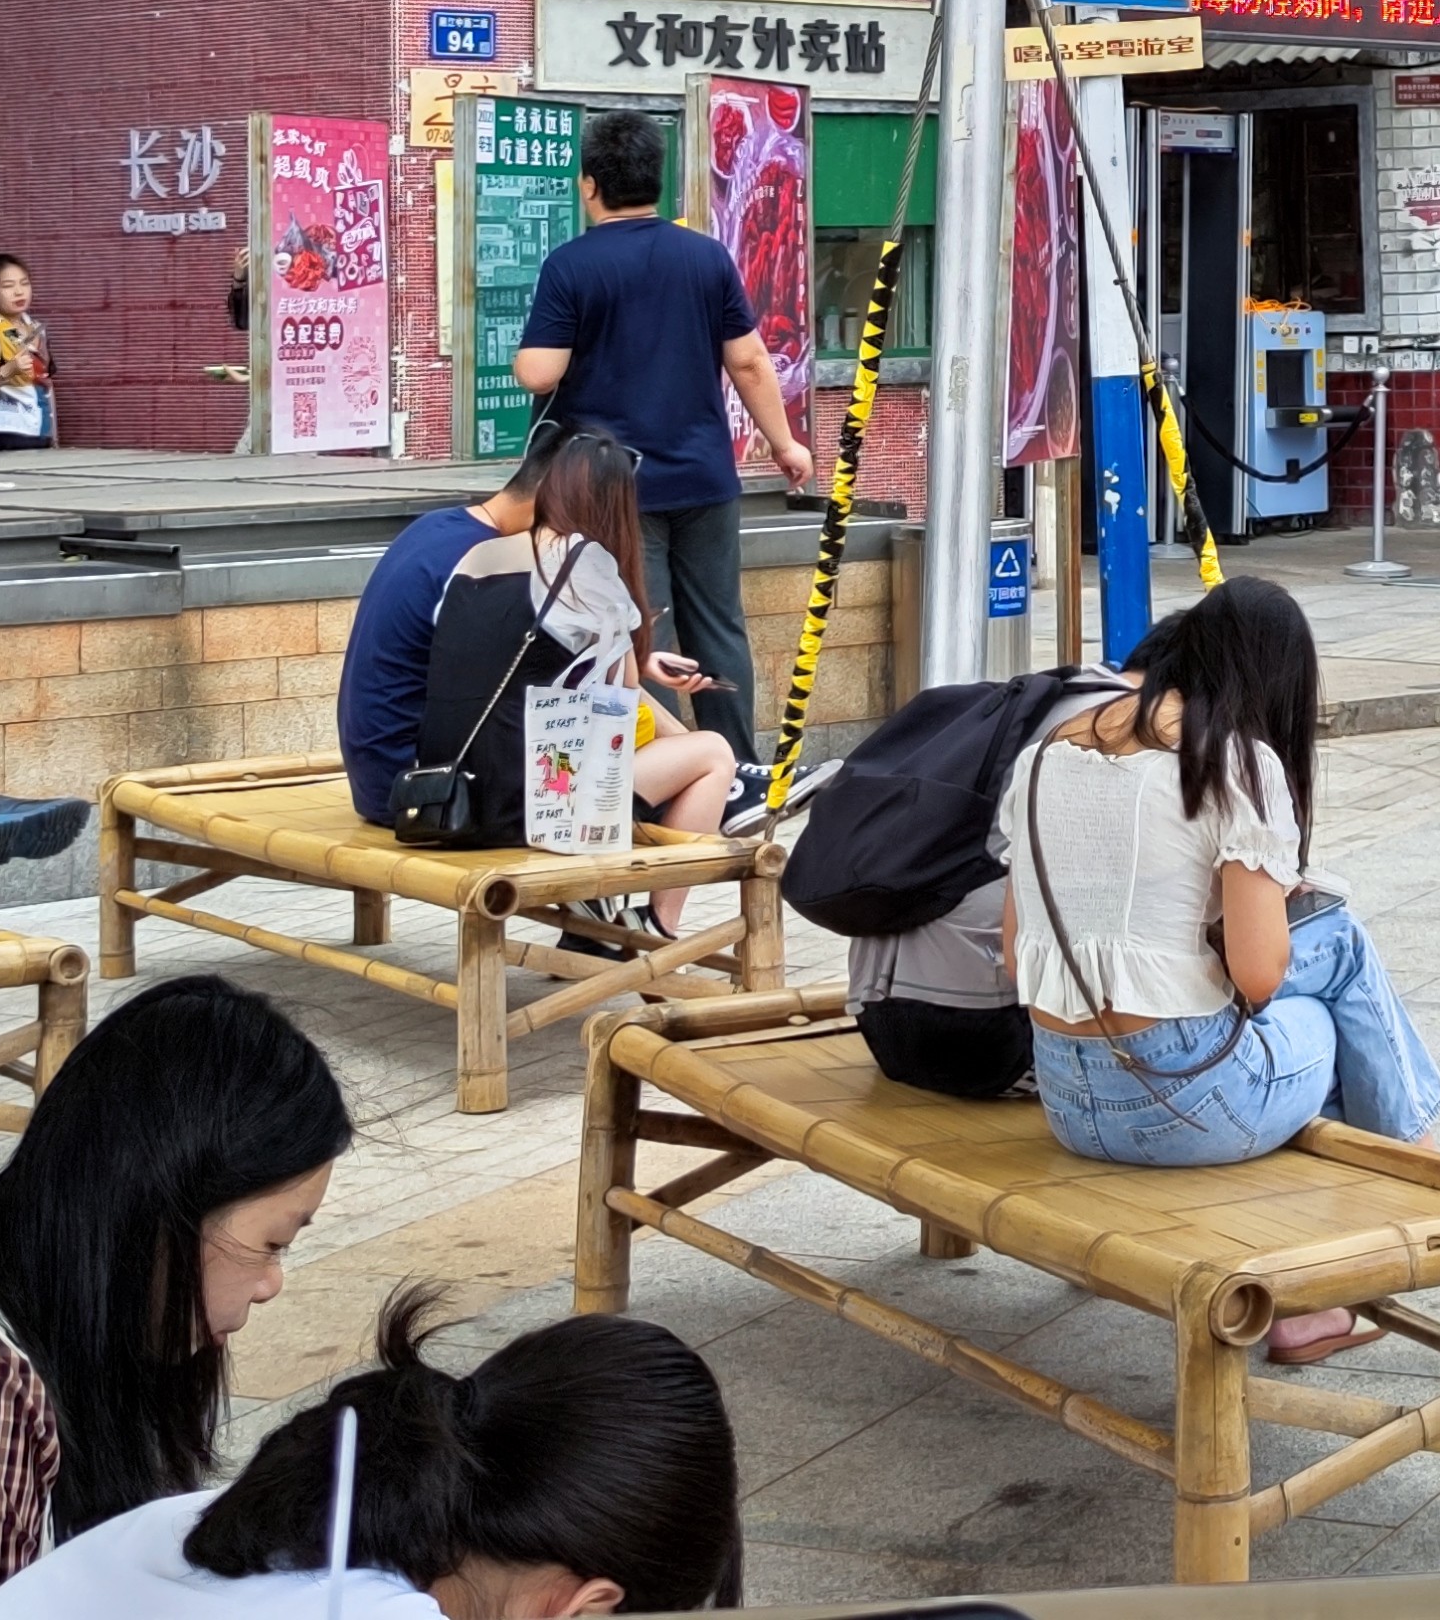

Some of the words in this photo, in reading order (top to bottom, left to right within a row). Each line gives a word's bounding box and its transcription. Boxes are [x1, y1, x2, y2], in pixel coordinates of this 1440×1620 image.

[447, 30, 475, 52] 94
[606, 11, 886, 73] 文和友外卖站
[120, 125, 226, 200] 长沙
[122, 209, 185, 236] Chang
[188, 206, 227, 231] sha
[282, 323, 342, 346] 免配送费
